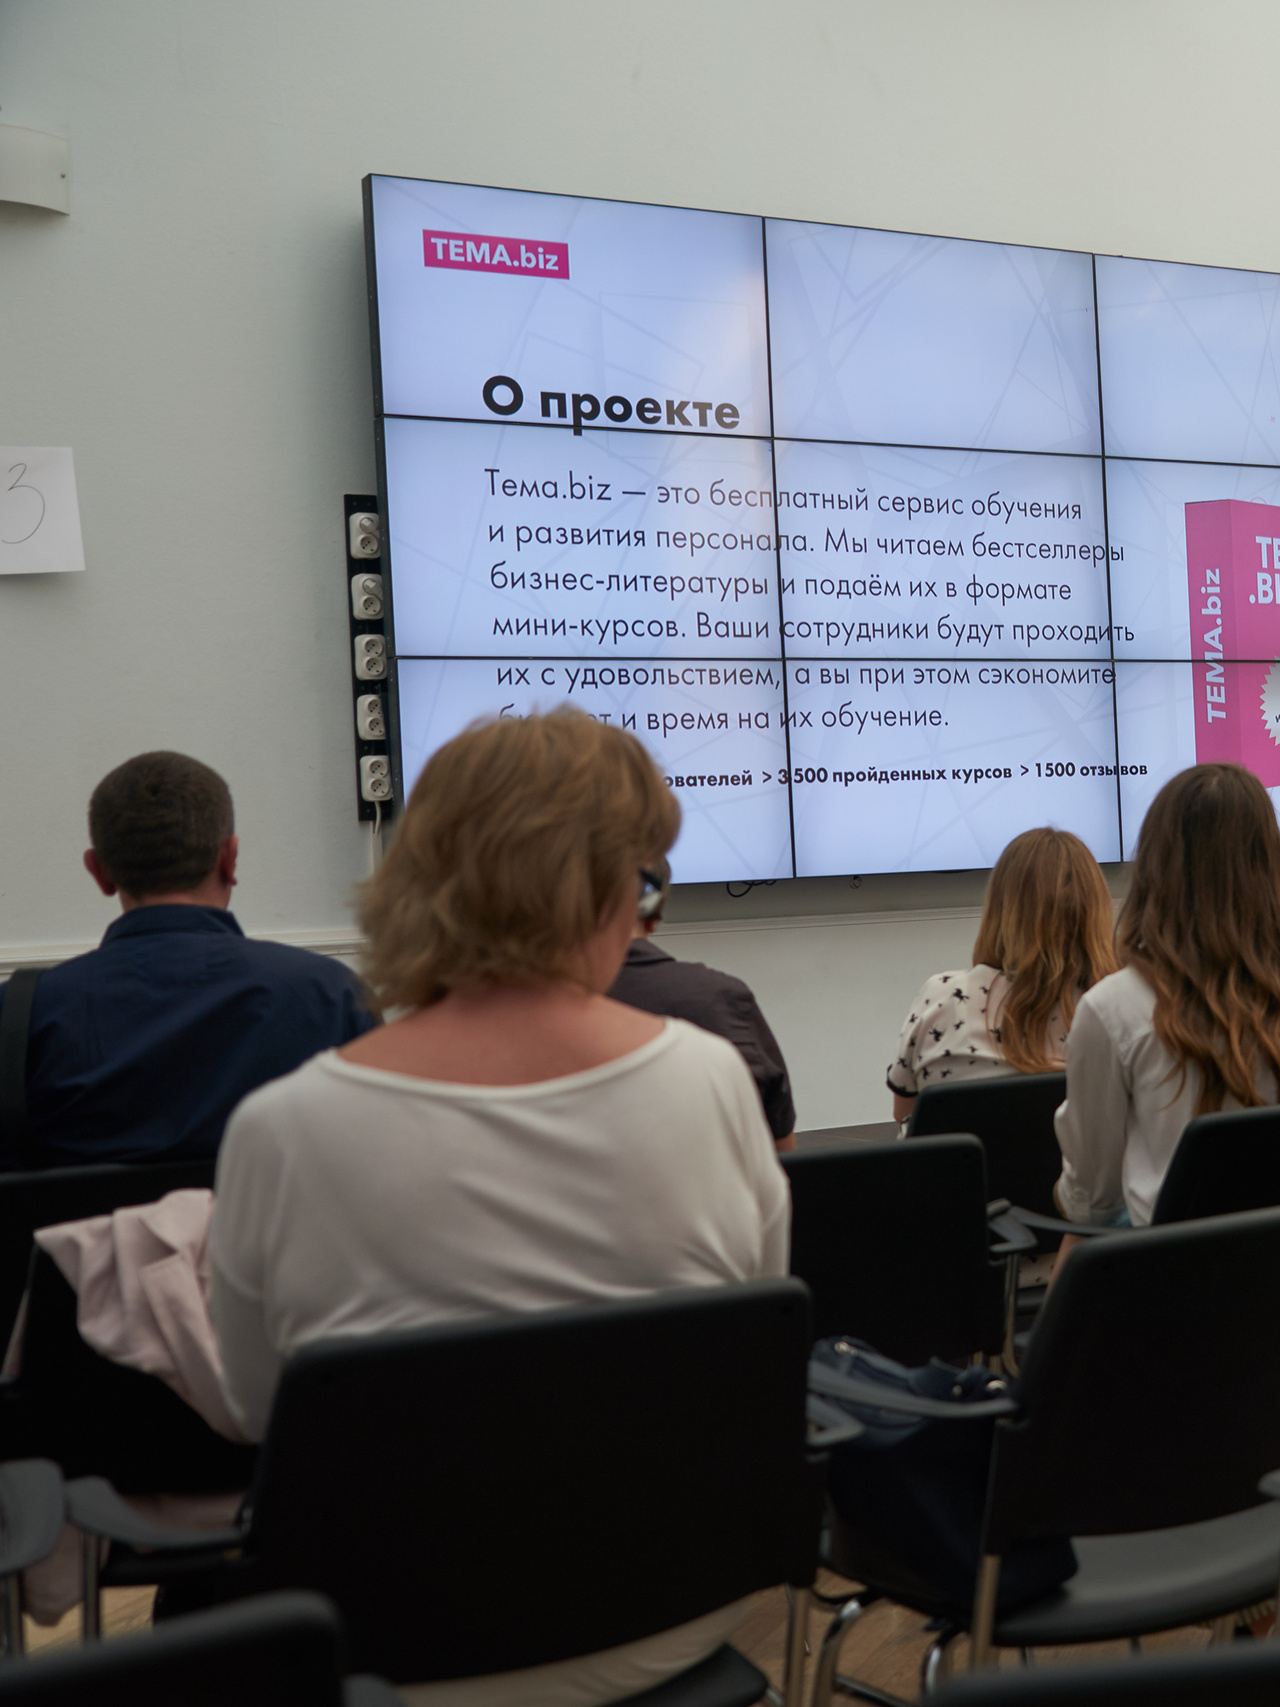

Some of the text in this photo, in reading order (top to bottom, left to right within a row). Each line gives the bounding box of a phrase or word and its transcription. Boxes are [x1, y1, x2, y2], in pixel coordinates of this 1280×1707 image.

[430, 237, 559, 271] TEMA.biz
[482, 375, 740, 436] О проекте
[1, 463, 46, 544] 3
[484, 468, 612, 501] Тема.biz
[656, 485, 700, 505] это
[709, 478, 869, 511] бесплатный
[878, 494, 964, 520] сервис
[971, 491, 1082, 524] обучения
[489, 525, 1124, 568] и развития персонала. Мы читаем бестселлеры
[490, 561, 1072, 606] бизнес-литературы и подаём их в формате
[493, 612, 1135, 648] мини-курсов. Ваши сотрудники будут проходить
[1201, 568, 1227, 723] TEMA.biz
[497, 666, 1116, 694] их с удовольствием, а вы при этом сэкономите
[622, 713, 637, 730] и
[647, 712, 728, 738] время
[739, 711, 769, 730] на
[780, 709, 813, 729] их
[821, 701, 949, 735] обучение.
[663, 770, 753, 788] ователей
[832, 766, 947, 787] пройденных
[952, 766, 1012, 784] курсов
[1035, 762, 1076, 778] 1500
[1080, 763, 1148, 777] отзывов
